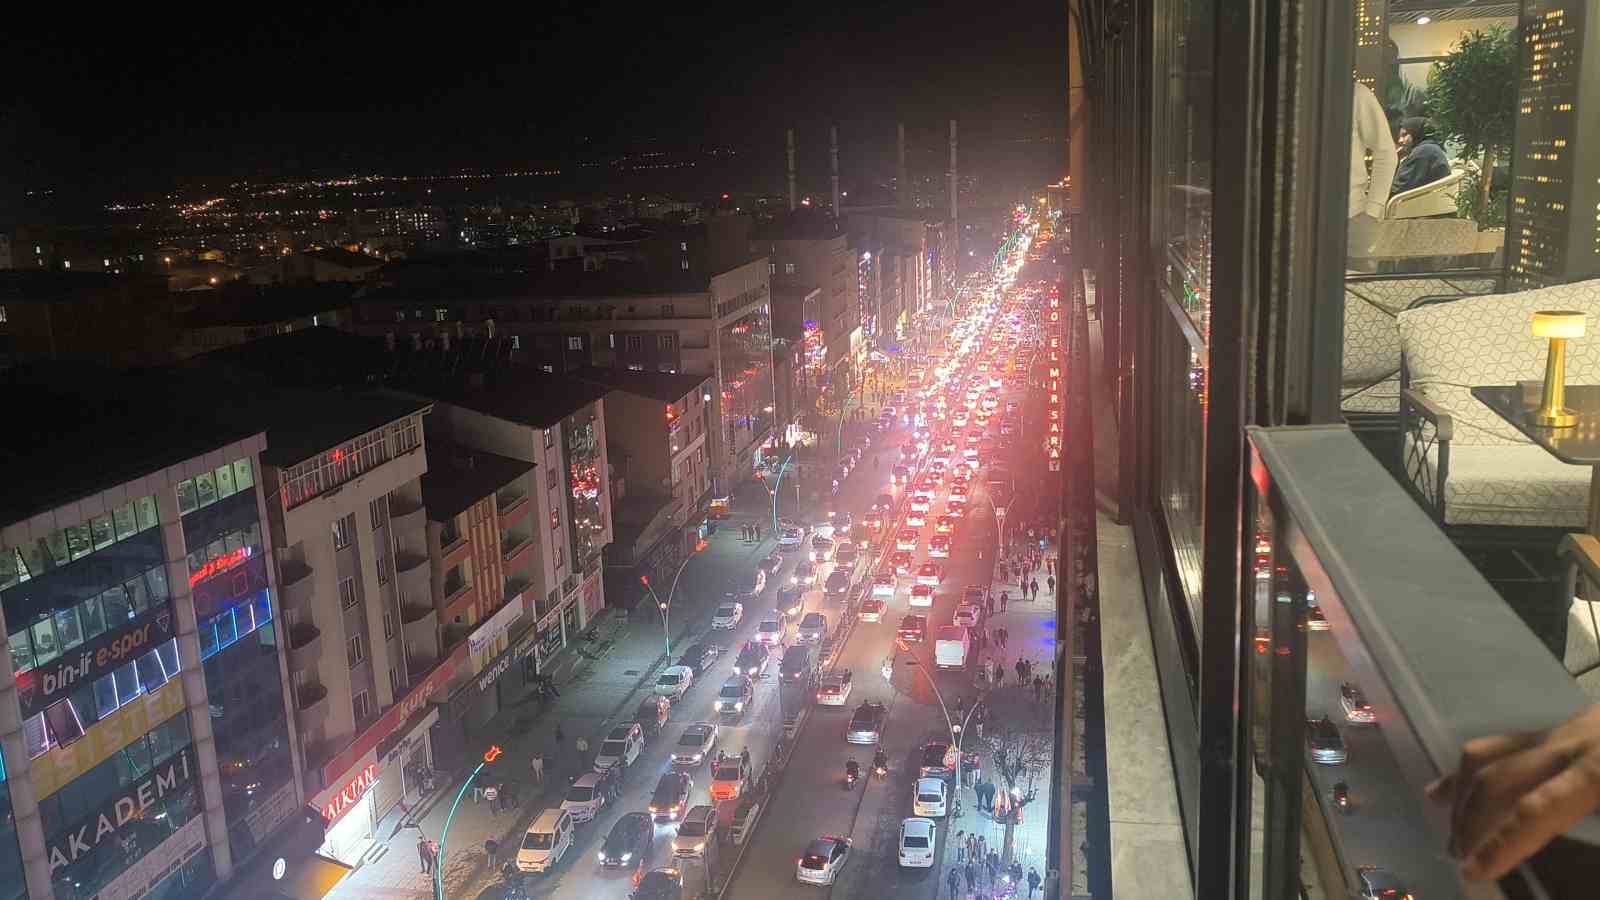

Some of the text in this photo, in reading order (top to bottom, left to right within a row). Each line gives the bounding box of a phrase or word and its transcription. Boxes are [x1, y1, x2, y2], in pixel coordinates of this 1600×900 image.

[1050, 299, 1059, 361] HOEL
[1049, 368, 1059, 404] MIR
[50, 751, 188, 869] AKADEMİ
